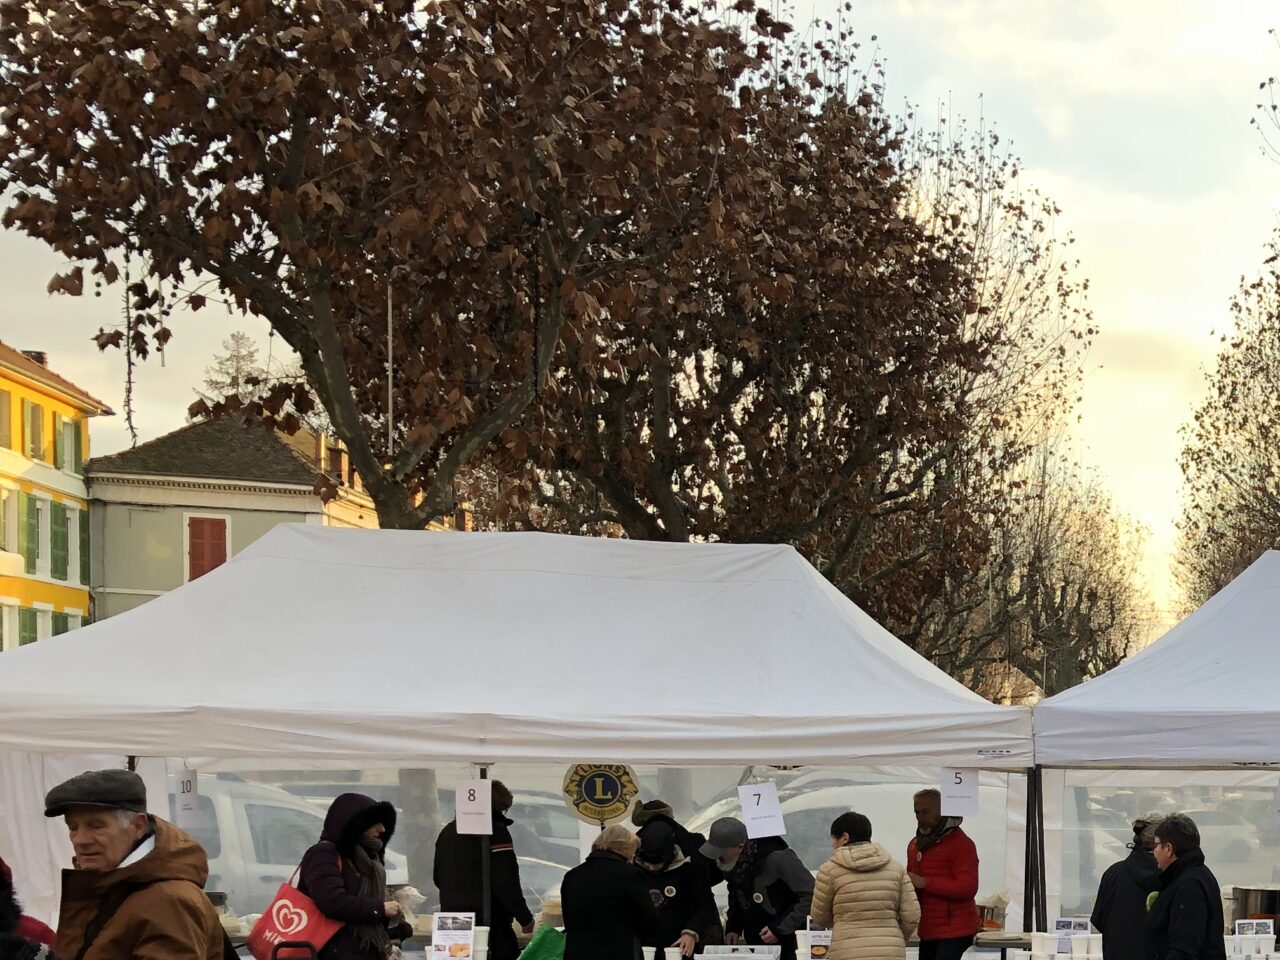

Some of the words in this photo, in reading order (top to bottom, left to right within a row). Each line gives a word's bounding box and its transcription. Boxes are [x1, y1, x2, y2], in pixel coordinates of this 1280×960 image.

[954, 772, 963, 785] 5
[181, 780, 191, 793] 10
[594, 778, 612, 799] L
[468, 789, 476, 801] 8
[753, 793, 761, 806] 7
